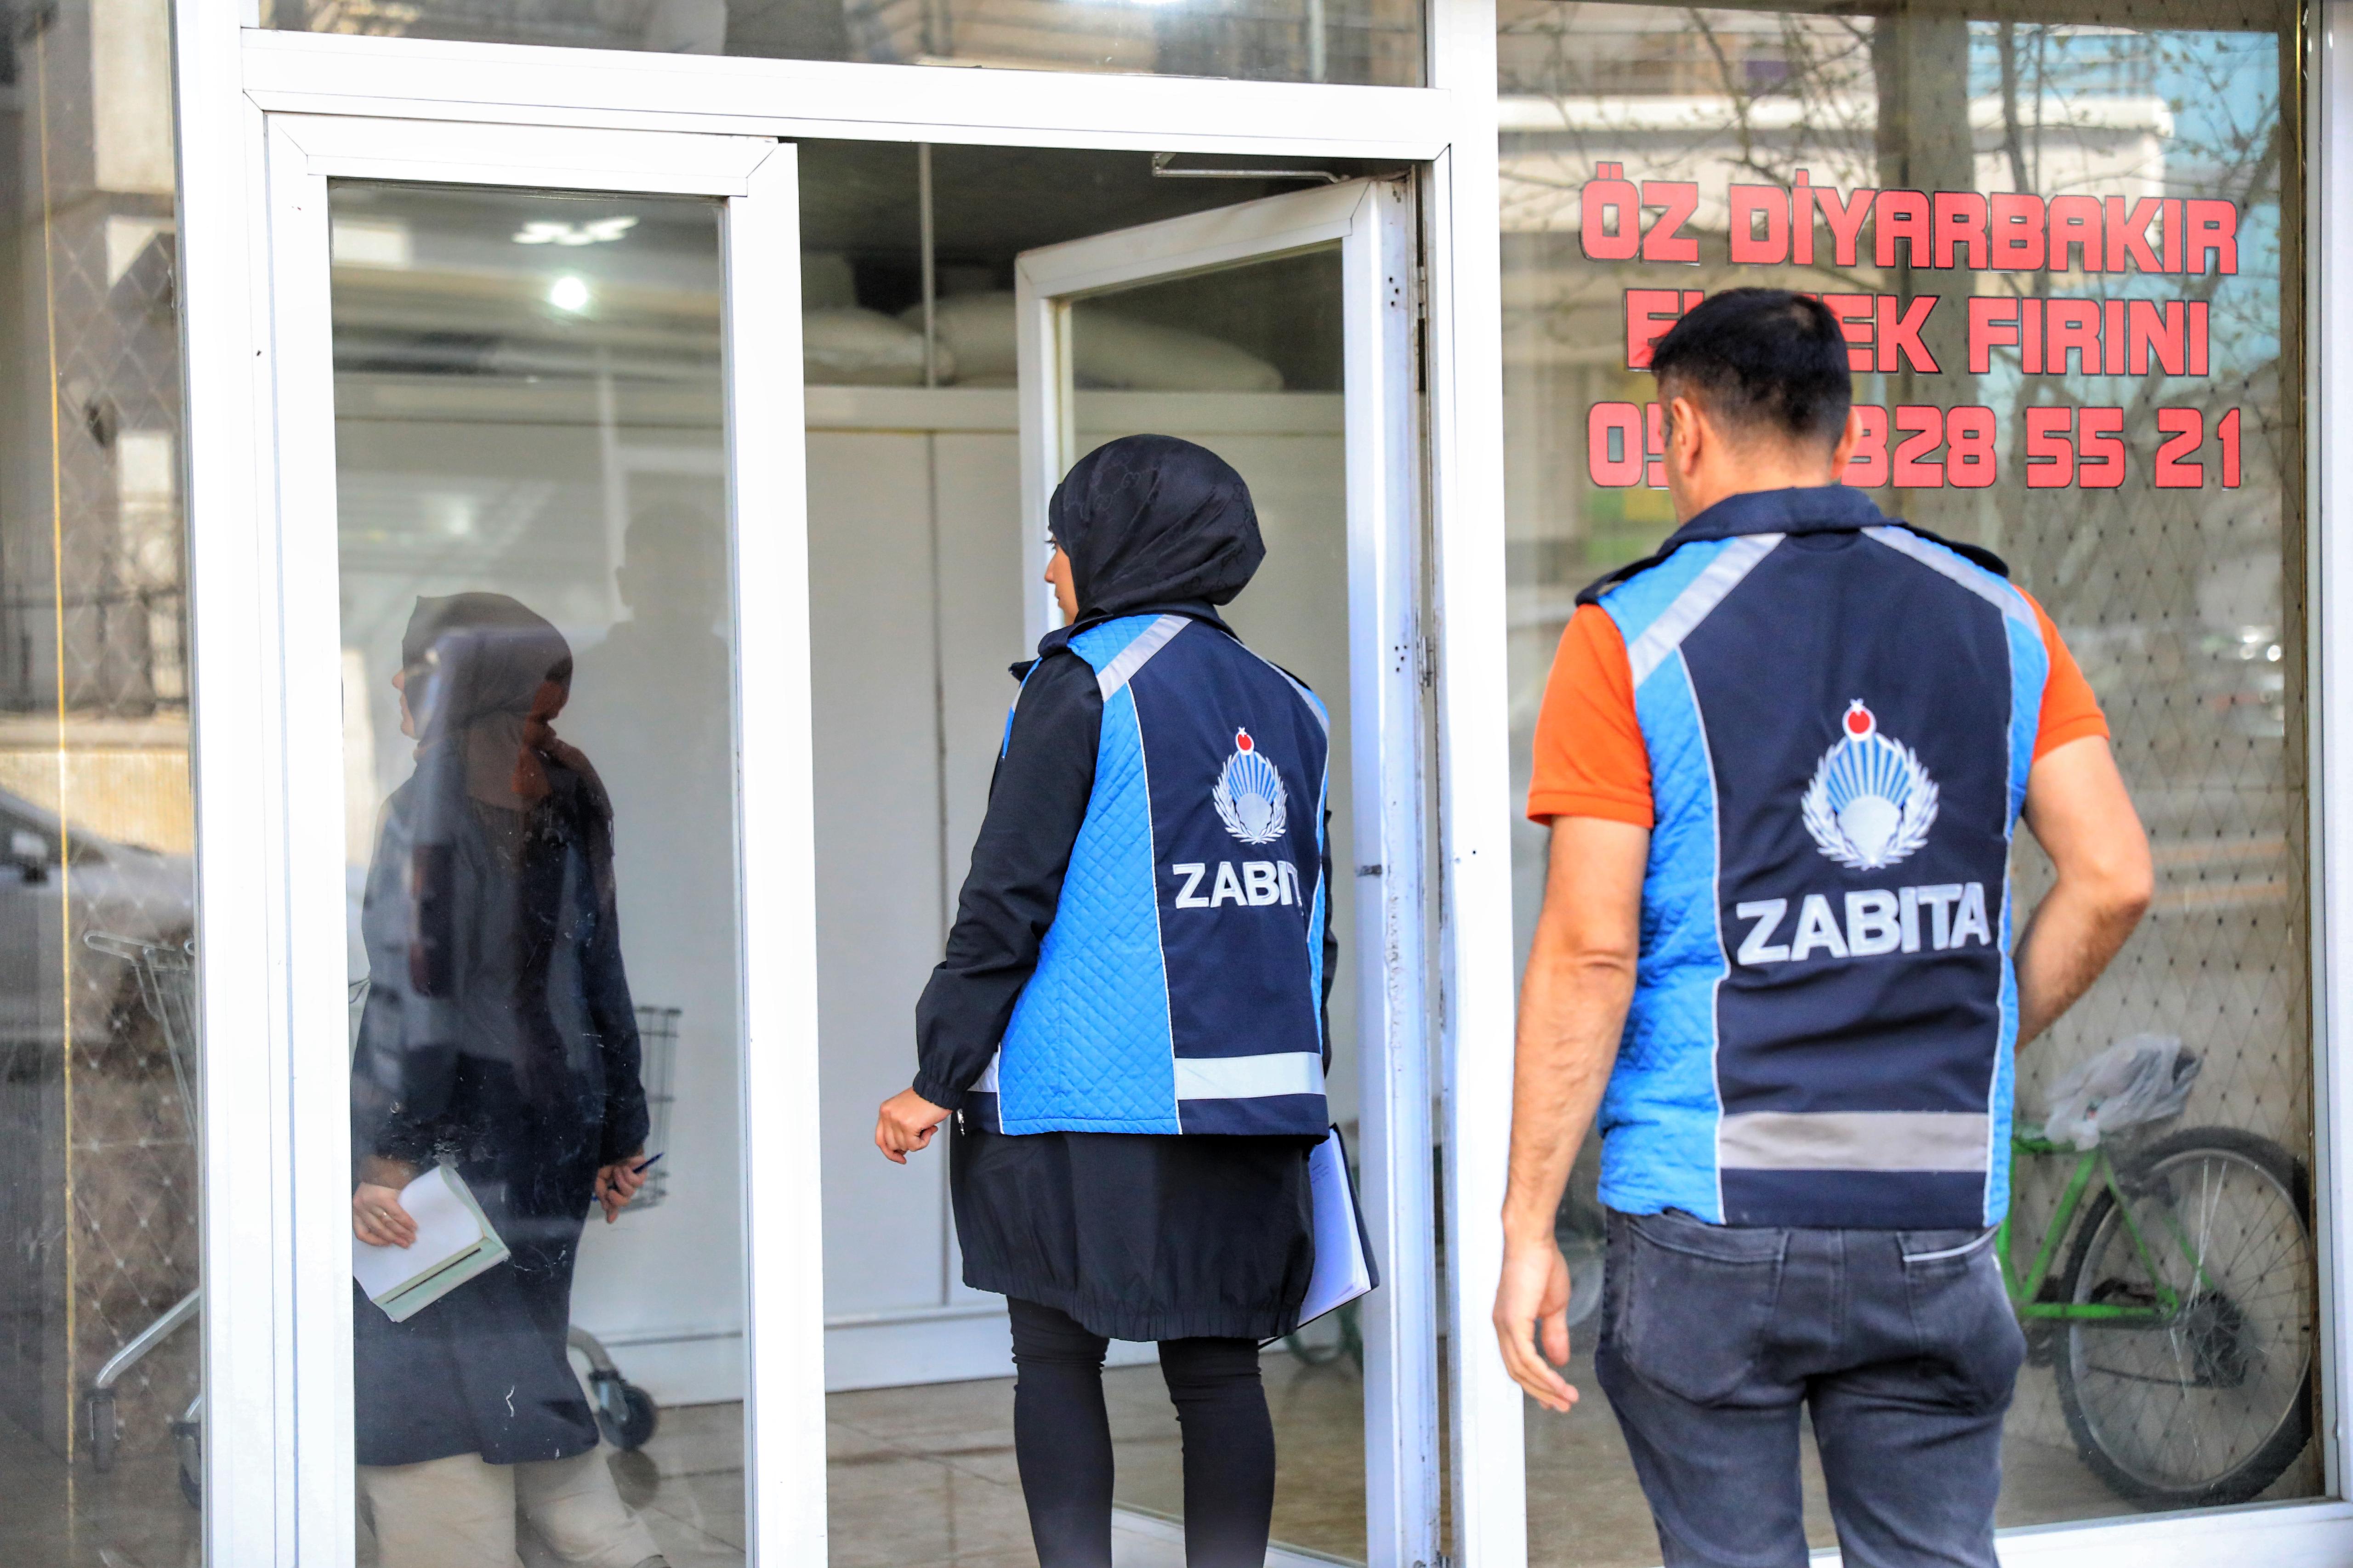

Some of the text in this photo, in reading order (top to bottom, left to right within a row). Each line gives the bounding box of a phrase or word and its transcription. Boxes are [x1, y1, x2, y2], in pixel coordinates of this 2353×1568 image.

[1581, 161, 2239, 275] ÖZ DİYARBAKIR
[1625, 289, 2209, 376] EEK FIRINI
[2025, 406, 2126, 488] 55
[2154, 407, 2241, 488] 21
[1173, 860, 1304, 915] ZABIT
[1736, 882, 1991, 966] ZABITA
